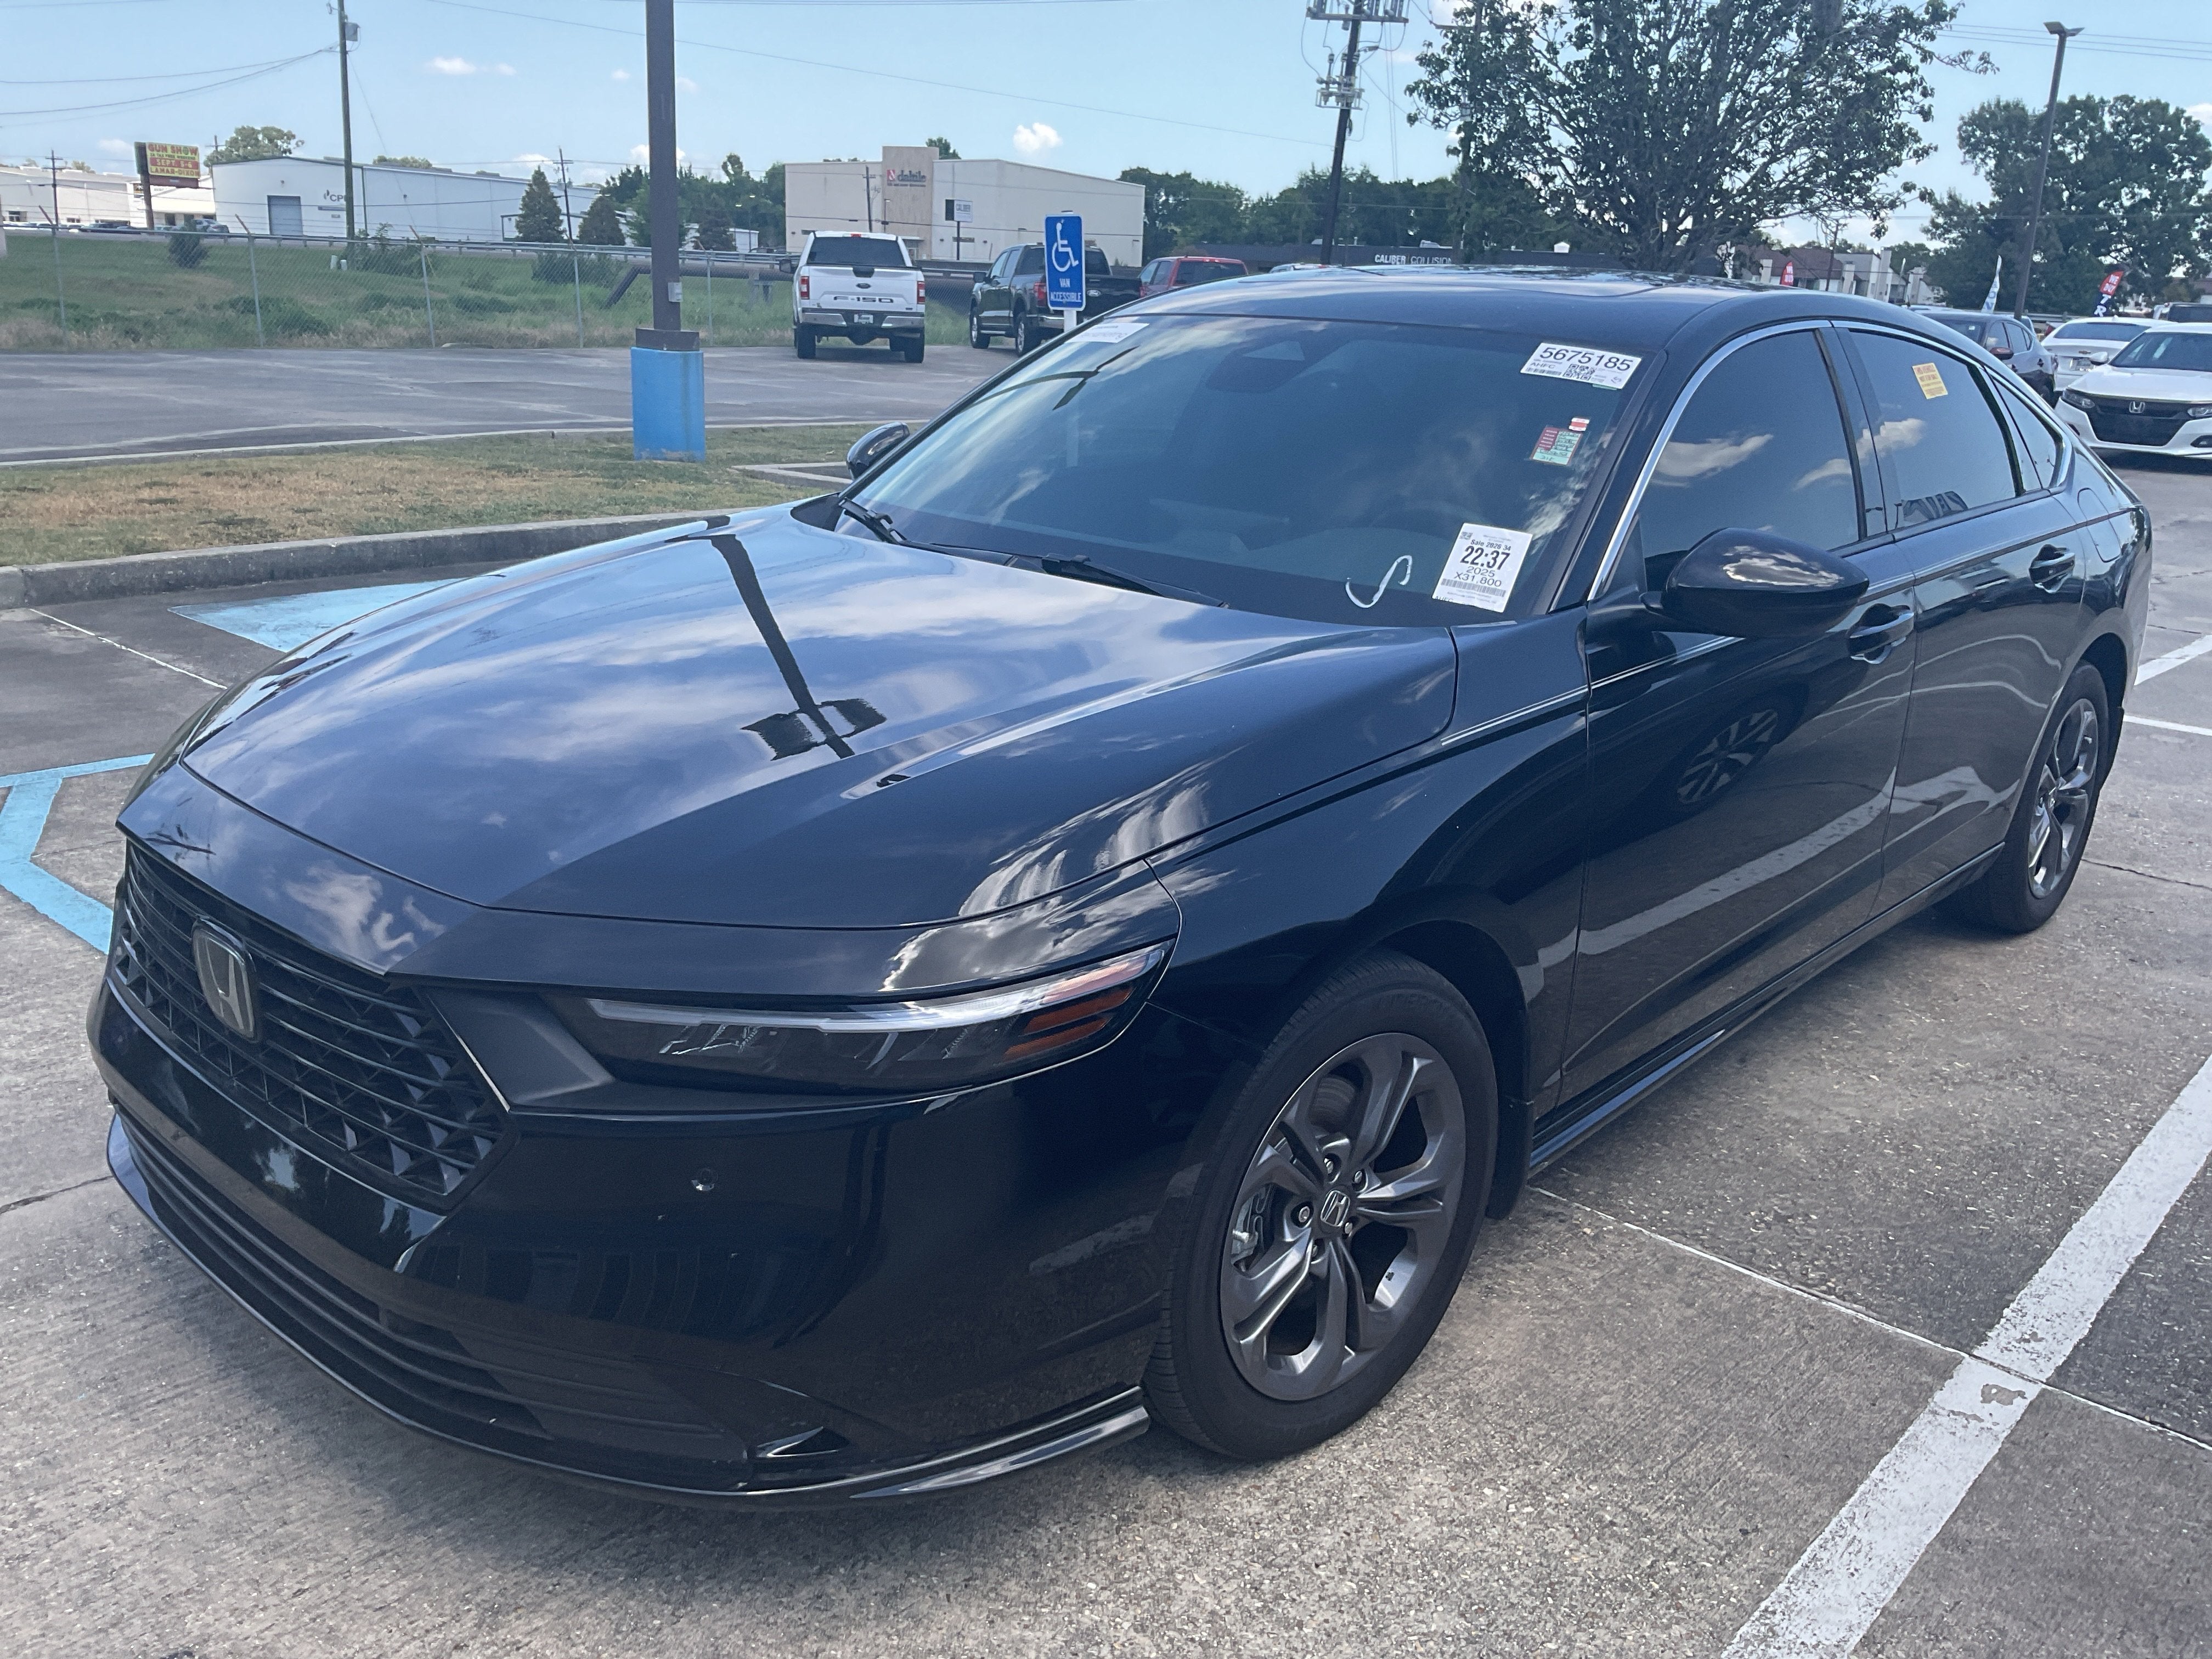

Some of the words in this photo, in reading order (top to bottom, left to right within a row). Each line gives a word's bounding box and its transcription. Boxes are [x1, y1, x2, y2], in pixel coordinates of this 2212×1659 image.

[148, 144, 167, 153] GUN
[170, 146, 198, 155] SHOW
[1374, 255, 1406, 264] CALIBER
[1059, 278, 1070, 287] VAN
[2109, 274, 2119, 284] WE
[1050, 292, 1081, 302] ACCESSIBLE
[1539, 347, 1633, 371] 5675185
[1460, 546, 1510, 570] 22:37
[1466, 566, 1496, 577] 2025
[1454, 572, 1502, 587] X31,800
